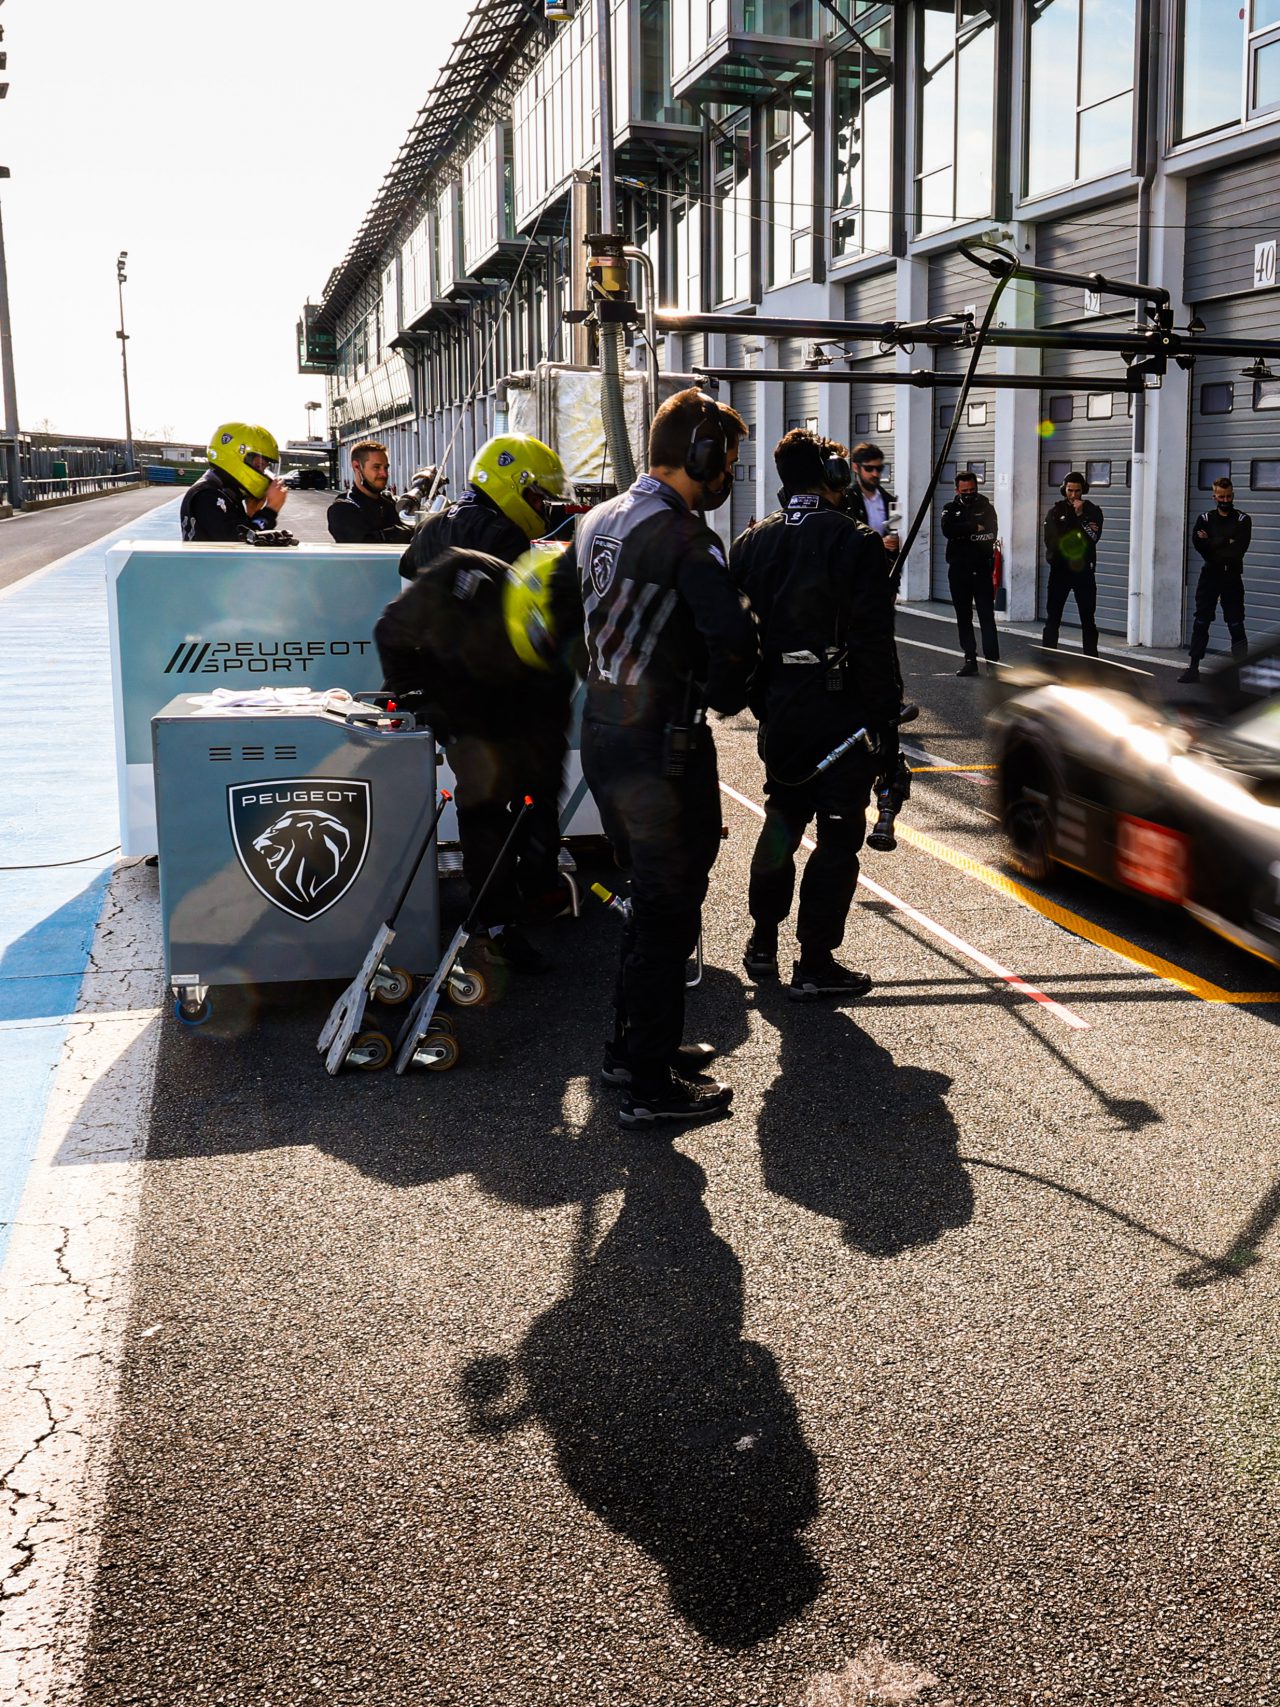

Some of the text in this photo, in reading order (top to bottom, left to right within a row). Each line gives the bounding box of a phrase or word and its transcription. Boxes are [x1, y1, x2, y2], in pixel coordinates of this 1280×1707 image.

[1256, 245, 1275, 282] 40
[211, 641, 371, 657] PEUGEOT
[201, 657, 314, 673] SPORT
[242, 790, 357, 807] PEUGEOT
